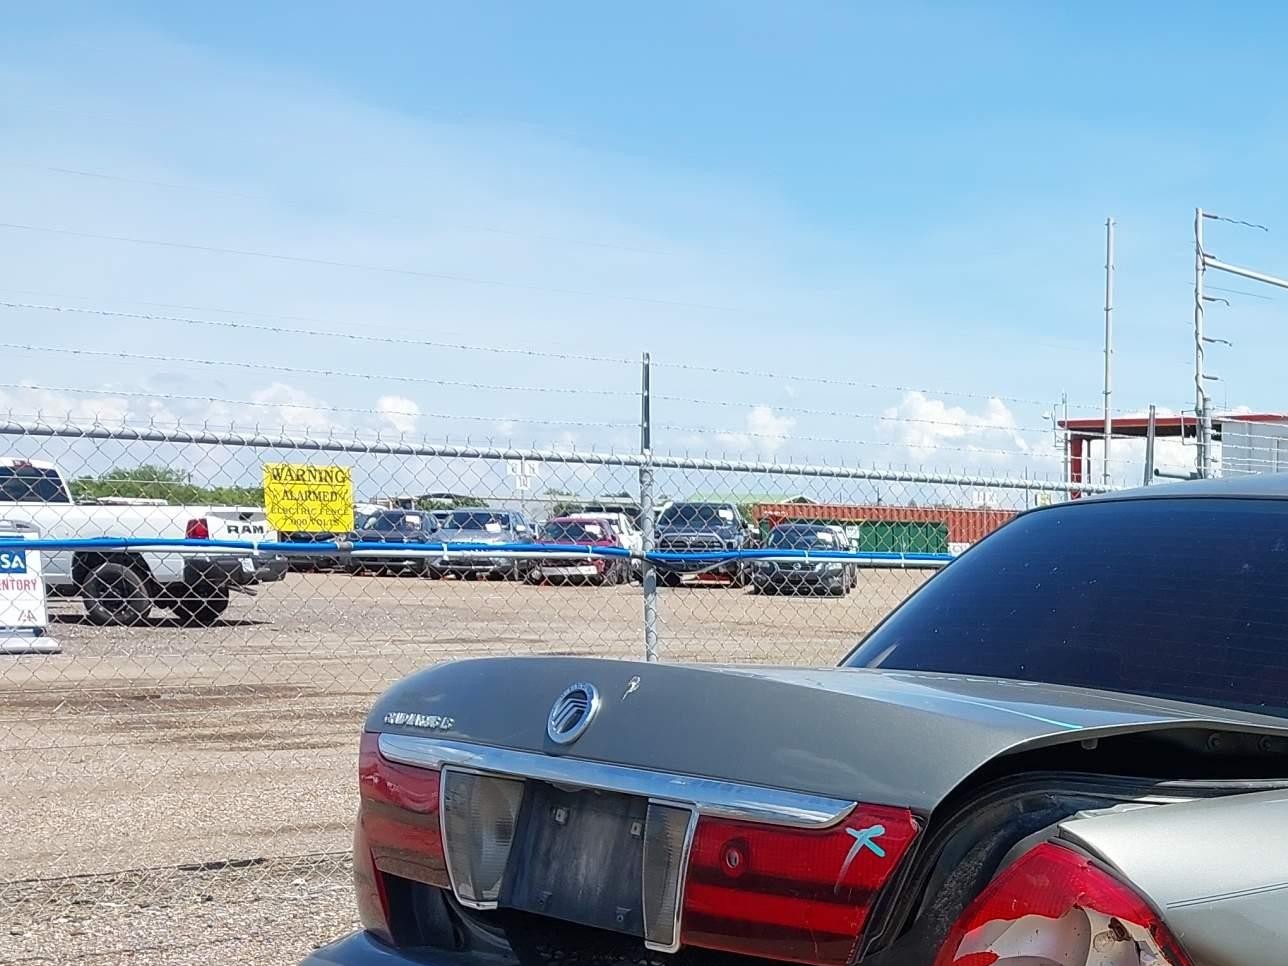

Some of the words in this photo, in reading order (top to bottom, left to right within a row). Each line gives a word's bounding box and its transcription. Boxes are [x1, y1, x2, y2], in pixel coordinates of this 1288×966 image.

[271, 468, 348, 483] WARNING
[281, 489, 338, 502] ALARMED
[271, 503, 317, 515] ELECTRIC
[320, 504, 350, 516] FENCE
[227, 525, 264, 534] RAM
